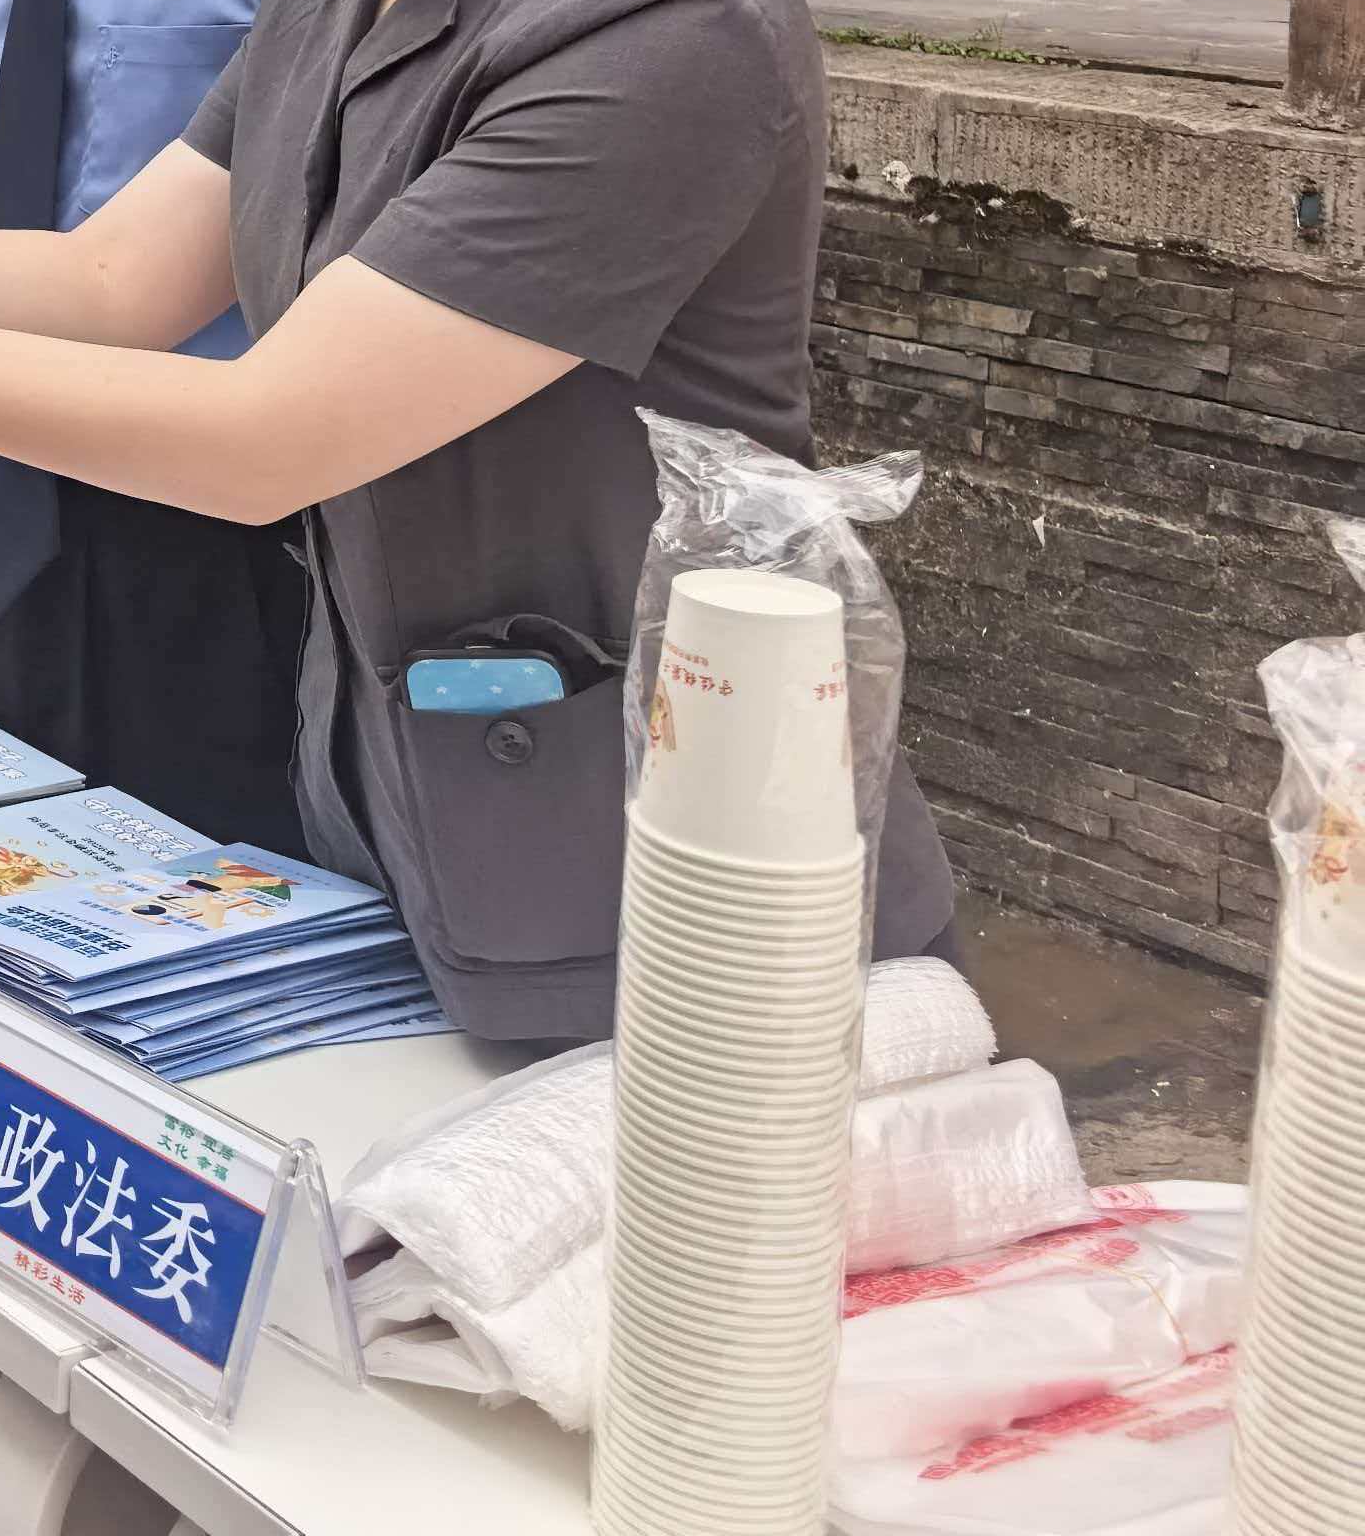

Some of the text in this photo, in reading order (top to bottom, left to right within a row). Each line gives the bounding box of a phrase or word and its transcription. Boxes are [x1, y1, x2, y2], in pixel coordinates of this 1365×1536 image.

[157, 1134, 188, 1160] 文化
[13, 1250, 86, 1305] 精彩生活
